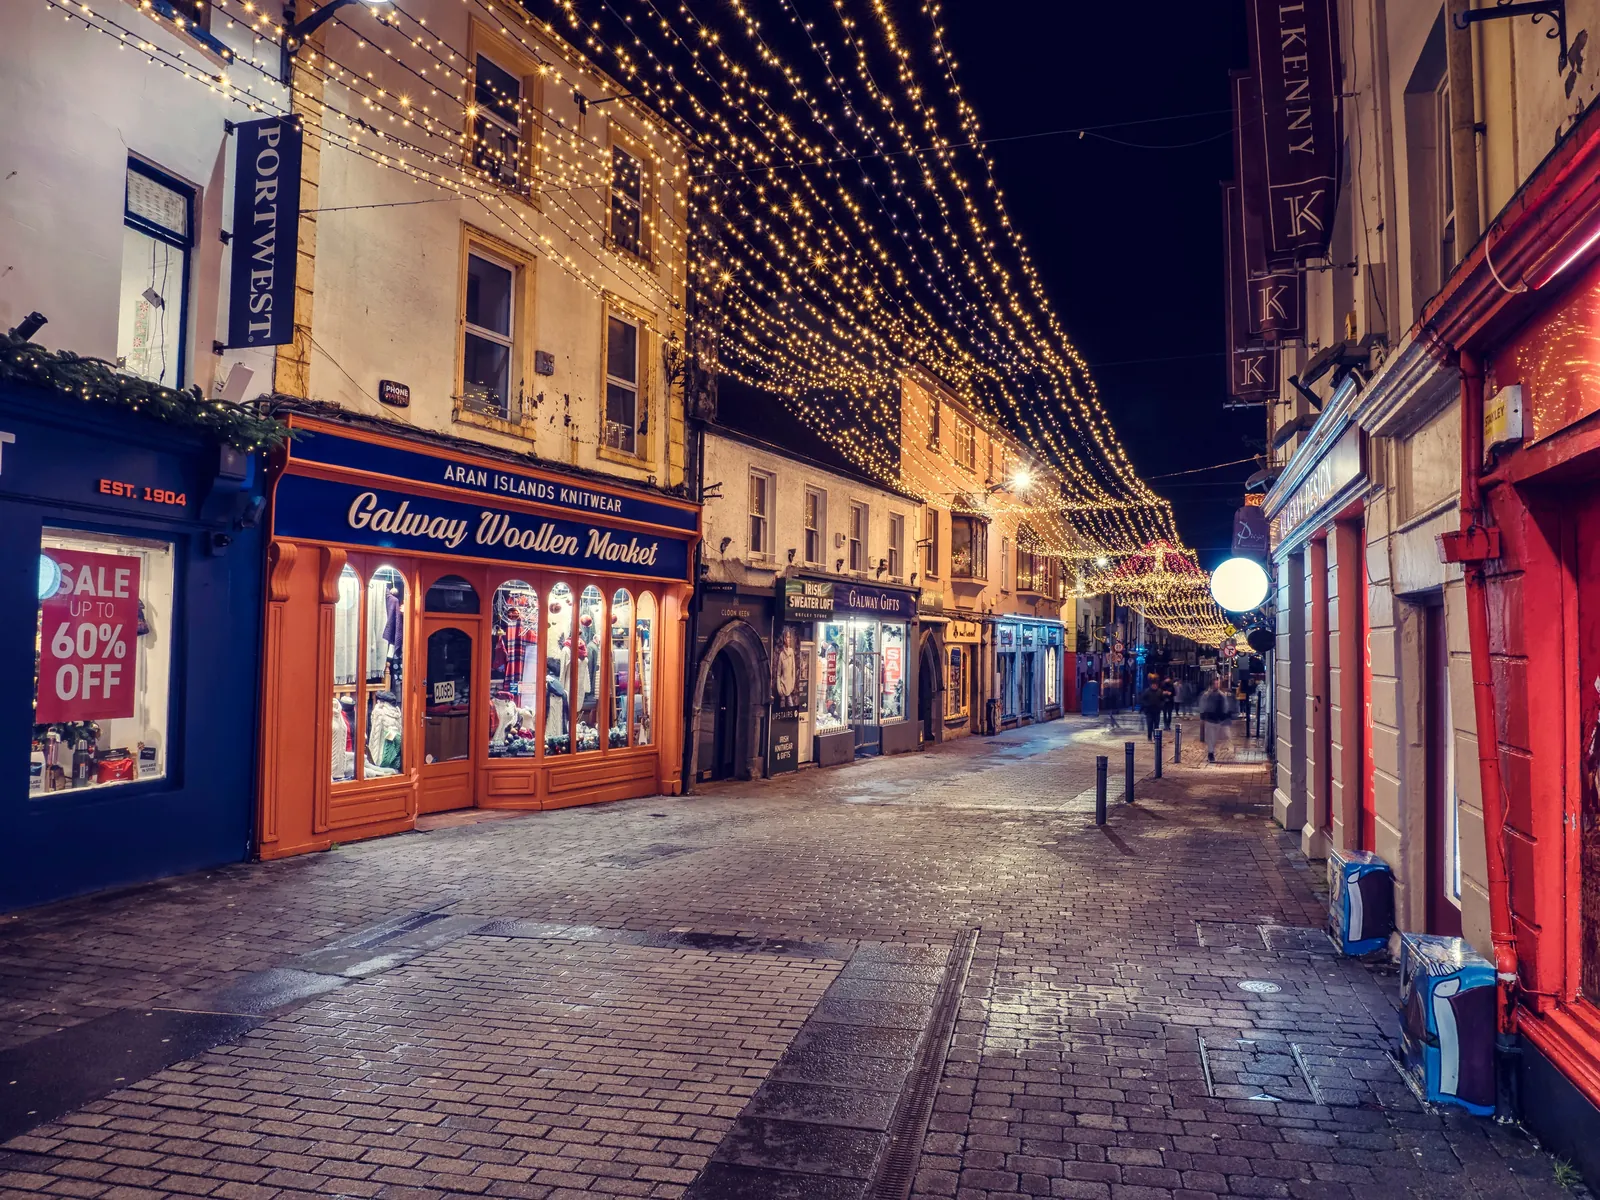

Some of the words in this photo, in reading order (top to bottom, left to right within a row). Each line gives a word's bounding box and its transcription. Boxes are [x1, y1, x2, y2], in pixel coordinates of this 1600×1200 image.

[1284, 189, 1325, 238] K
[249, 123, 281, 340] PORTWEST
[1258, 285, 1289, 322] K
[1240, 355, 1267, 386] K
[386, 385, 409, 397] PHONE
[100, 479, 137, 499] EST.
[143, 487, 187, 507] 1904
[443, 464, 487, 487] ARAN
[493, 476, 555, 500] ISLANDS
[560, 488, 622, 513] KNITWEAR
[1305, 456, 1332, 515] DESIGN
[348, 491, 467, 548] Galway
[475, 511, 580, 556] Woollen
[584, 528, 658, 566] Market
[58, 563, 131, 598] SALE
[805, 583, 822, 596] IRISH
[70, 601, 92, 618] UP
[96, 601, 115, 618] TO
[789, 595, 819, 609] SWEATER
[820, 598, 834, 610] LOFT
[51, 622, 126, 659] 60%
[55, 663, 122, 701] OFF
[886, 649, 901, 693] SALE
[436, 682, 454, 700] CLOSED
[772, 710, 793, 721] UPSTAIRS
[775, 742, 794, 752] KNITWEAR
[780, 735, 790, 743] IRISH
